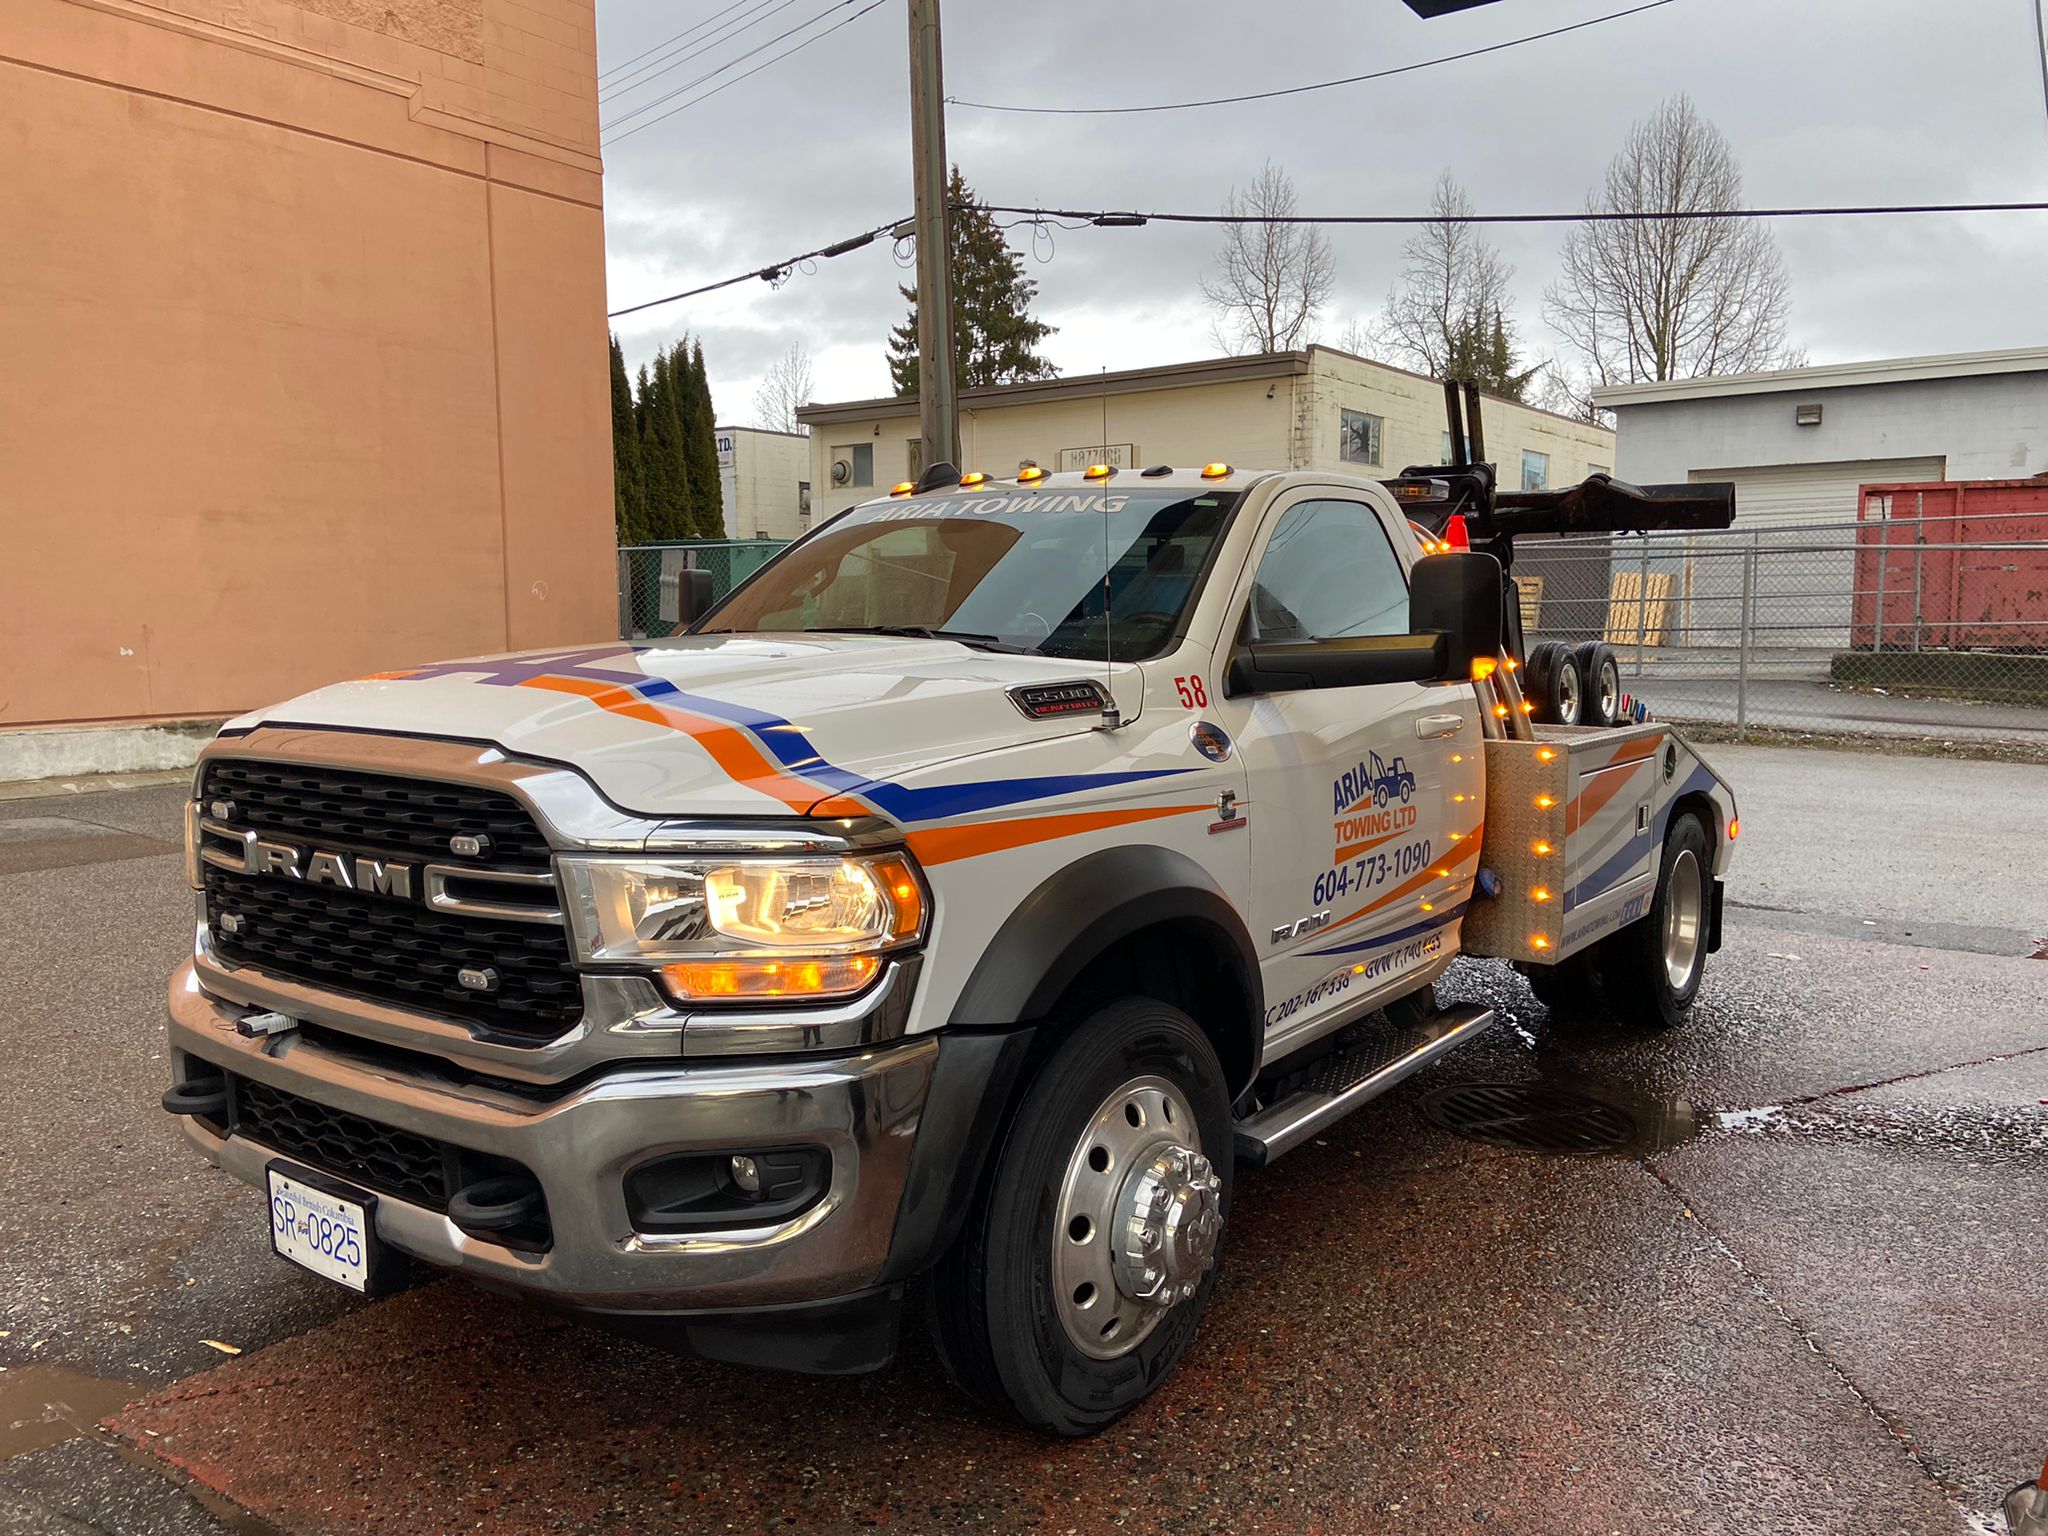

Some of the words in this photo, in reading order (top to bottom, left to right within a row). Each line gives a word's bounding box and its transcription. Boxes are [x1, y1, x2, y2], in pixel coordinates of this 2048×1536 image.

[867, 502, 949, 523] ARIA
[954, 495, 1130, 516] TOWING
[1026, 687, 1093, 704] 5500
[1174, 674, 1208, 711] 58
[1334, 761, 1373, 816] ARIA
[1334, 810, 1391, 844] TOWING
[1393, 805, 1417, 830] LTD
[257, 840, 411, 899] RAM
[1313, 839, 1431, 906] 604-773-1090
[1270, 910, 1331, 945] RAM
[1275, 969, 1351, 1024] 202-167-538
[1365, 950, 1392, 980] GVW
[1394, 941, 1421, 970] 7,740
[1423, 930, 1443, 956] KGS
[273, 1196, 297, 1241] SR
[308, 1212, 361, 1267] 0825
[322, 1205, 355, 1226] Columbia
